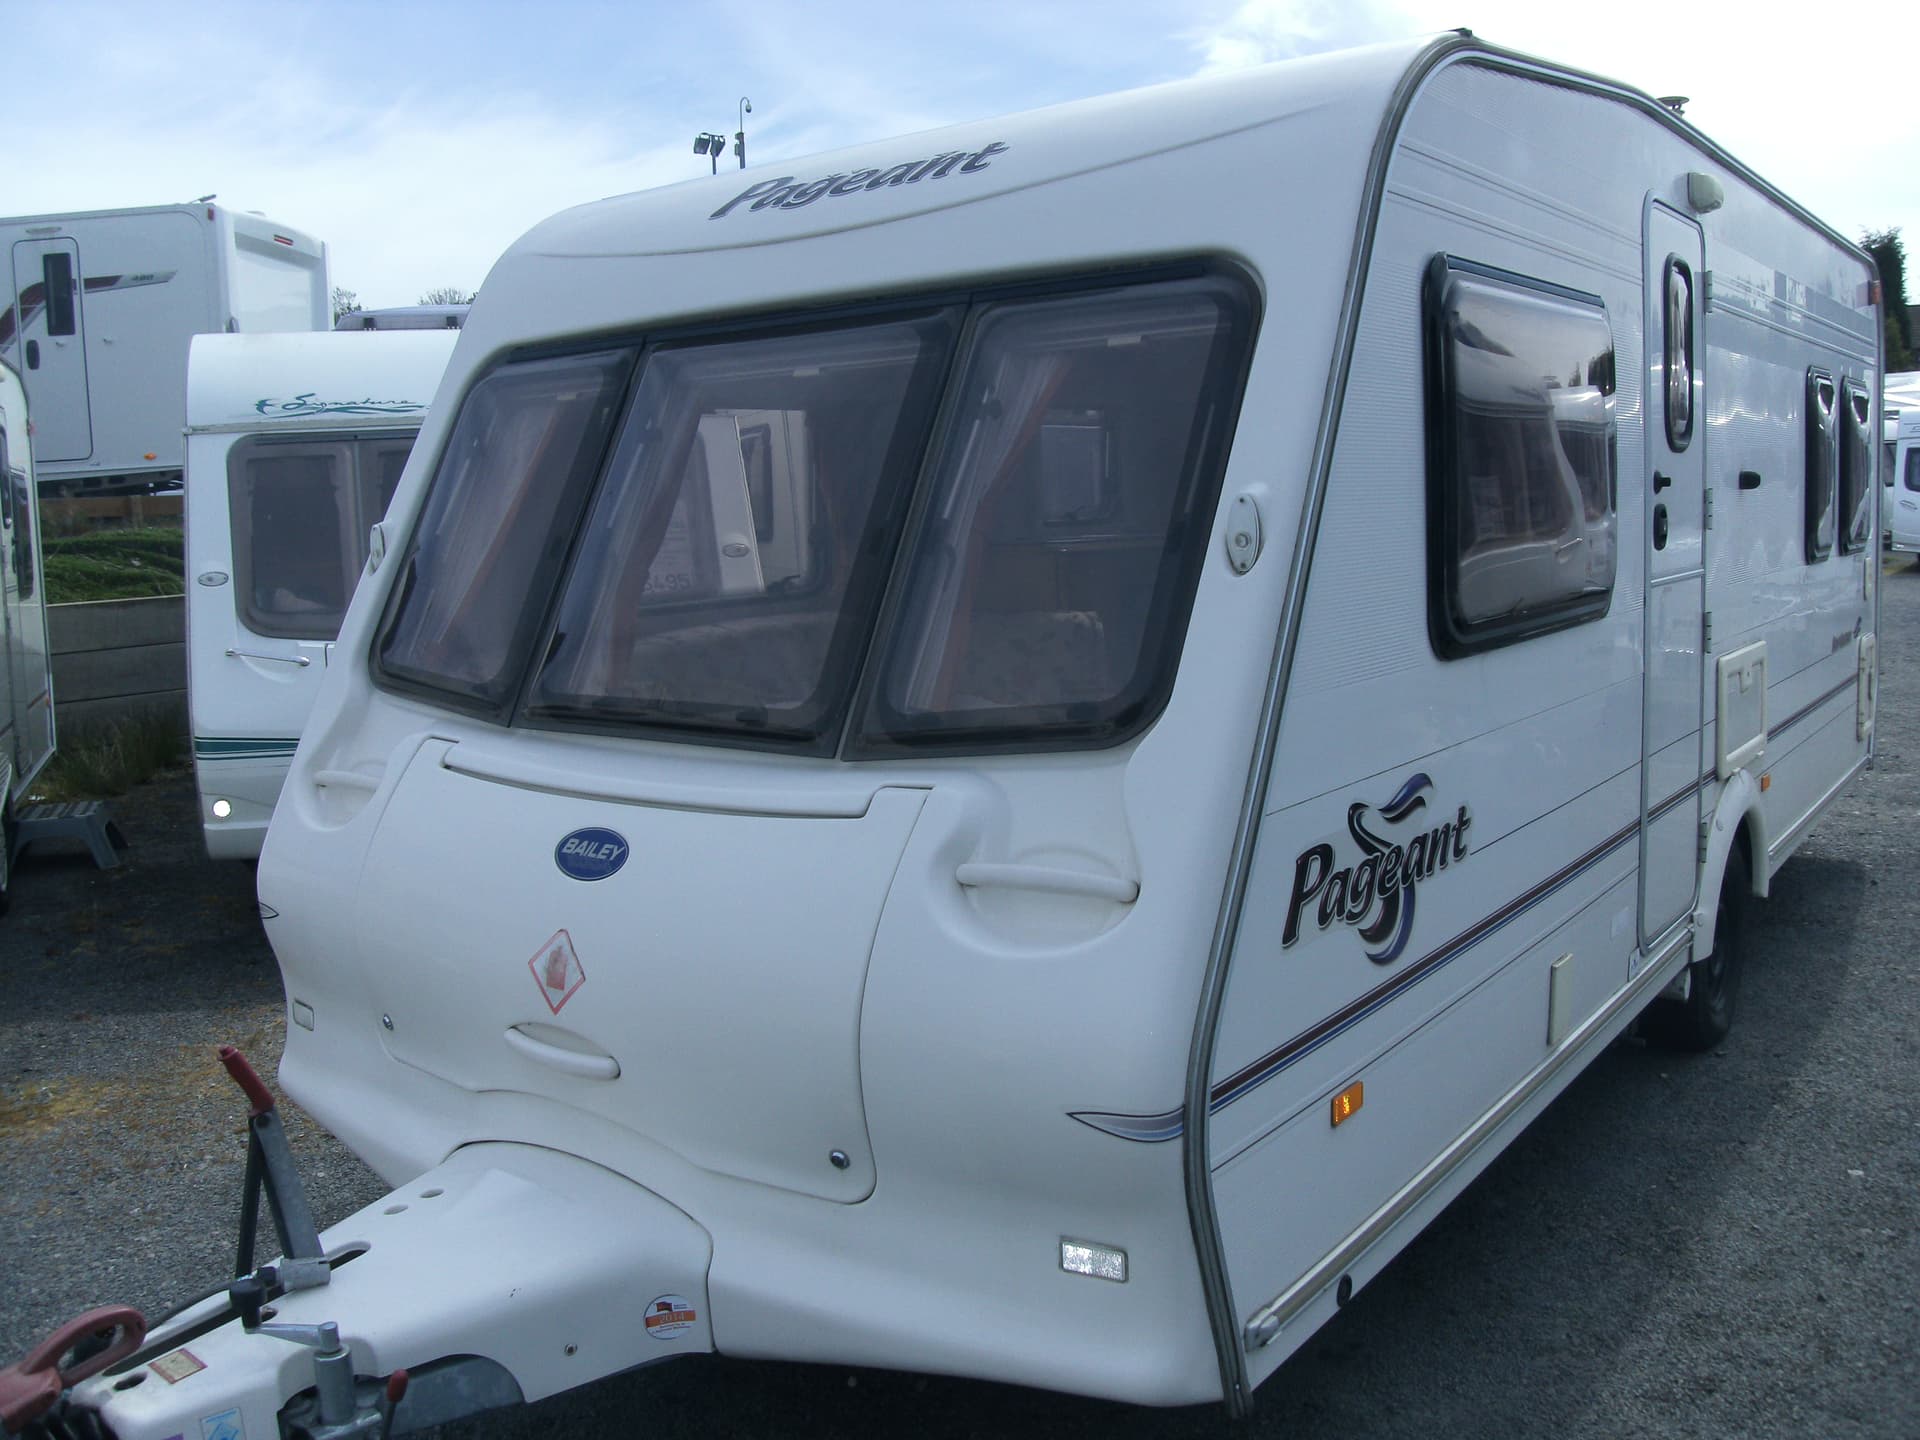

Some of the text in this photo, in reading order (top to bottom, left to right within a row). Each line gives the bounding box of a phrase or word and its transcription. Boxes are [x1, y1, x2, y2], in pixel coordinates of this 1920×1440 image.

[708, 141, 1010, 220] Pageant
[561, 838, 625, 861] BAILEY
[1282, 805, 1471, 948] Pageant
